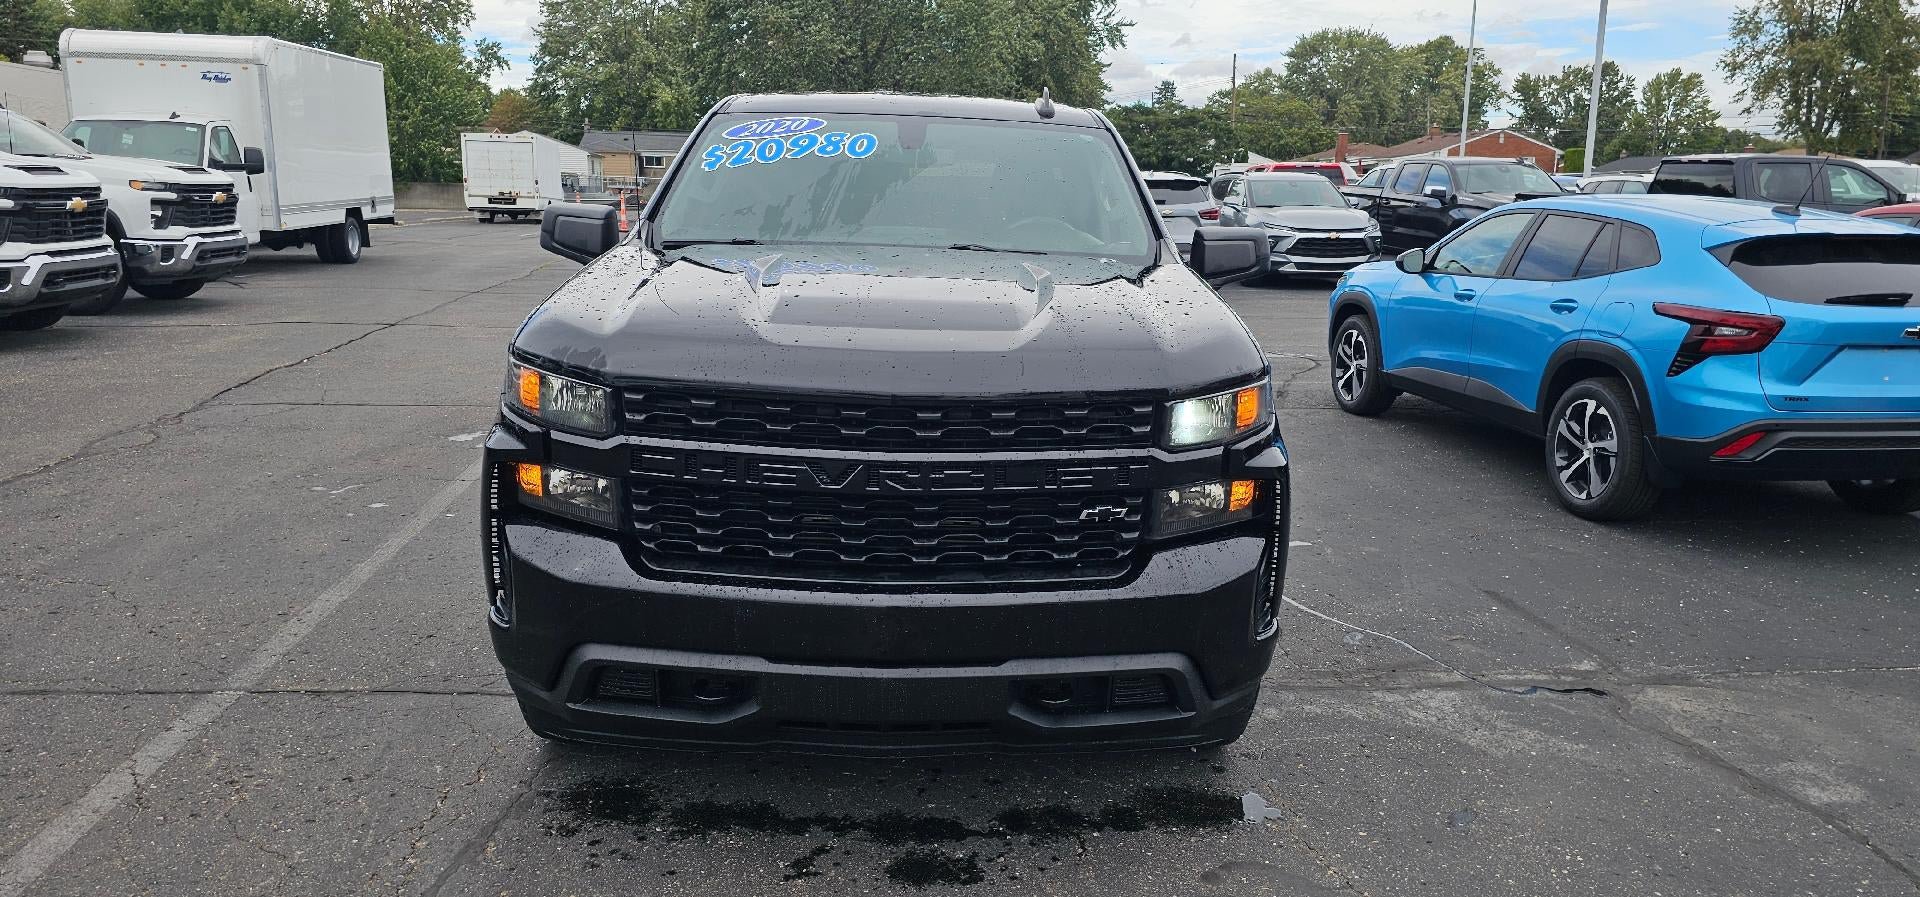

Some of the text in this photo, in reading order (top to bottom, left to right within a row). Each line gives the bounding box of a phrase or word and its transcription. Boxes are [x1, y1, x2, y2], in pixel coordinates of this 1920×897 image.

[737, 119, 808, 137] 2020
[701, 132, 878, 171] $20980
[630, 449, 1149, 490] CHEVROLET
